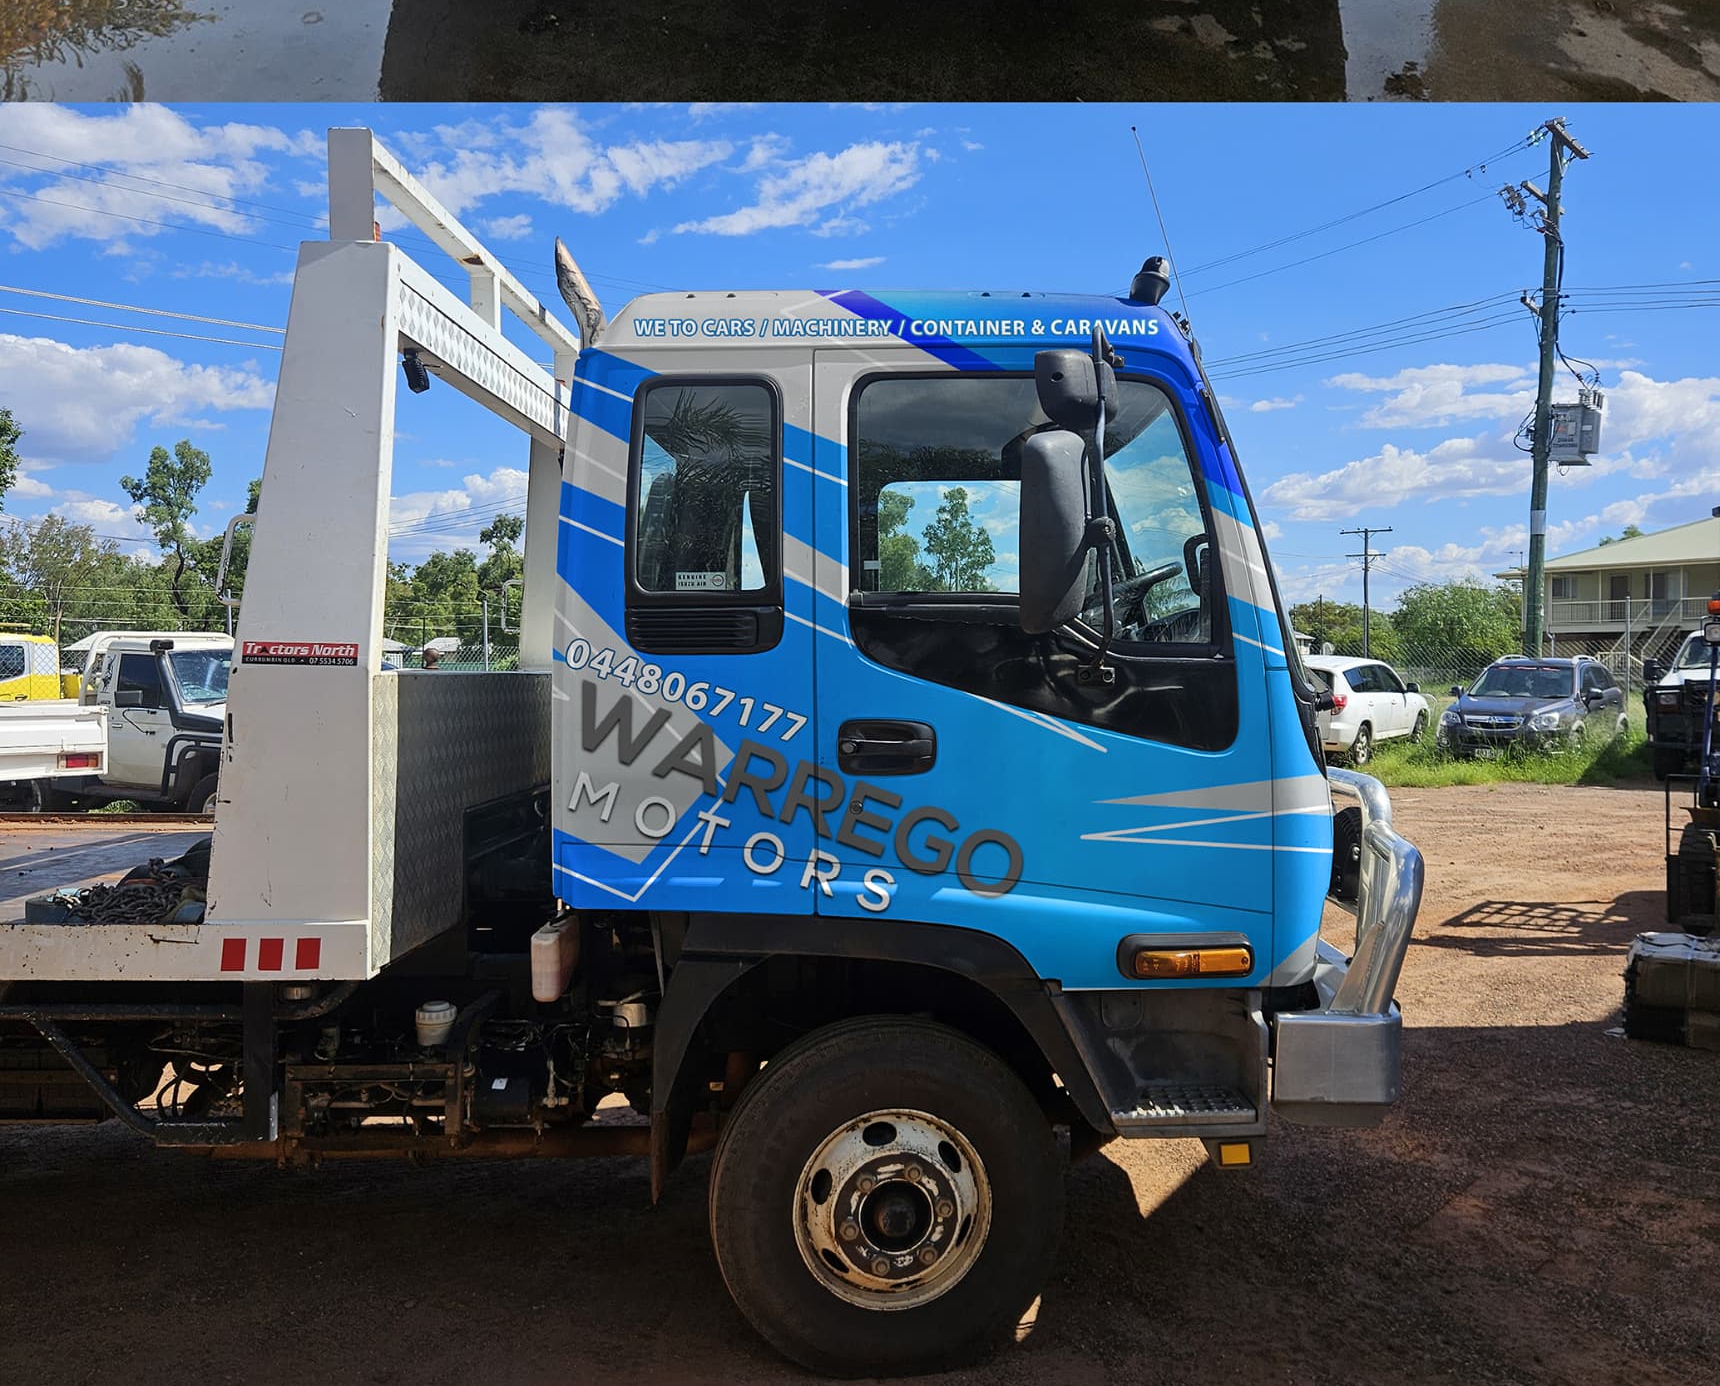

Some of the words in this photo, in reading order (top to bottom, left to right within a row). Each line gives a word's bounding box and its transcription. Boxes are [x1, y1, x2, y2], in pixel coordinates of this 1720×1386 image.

[634, 319, 665, 337] WE
[668, 319, 697, 337] TO
[700, 319, 755, 337] CARS
[759, 319, 767, 337] /
[772, 319, 893, 337] MACHINERY
[898, 319, 905, 337] /
[910, 319, 1025, 336] CONTAINER
[1031, 319, 1045, 336] &
[309, 657, 318, 665] 07
[337, 658, 354, 666] 5706
[311, 645, 355, 656] North
[565, 638, 808, 741] 0448067177
[582, 679, 1023, 898] WARREGO
[567, 771, 897, 913] MOTORS
